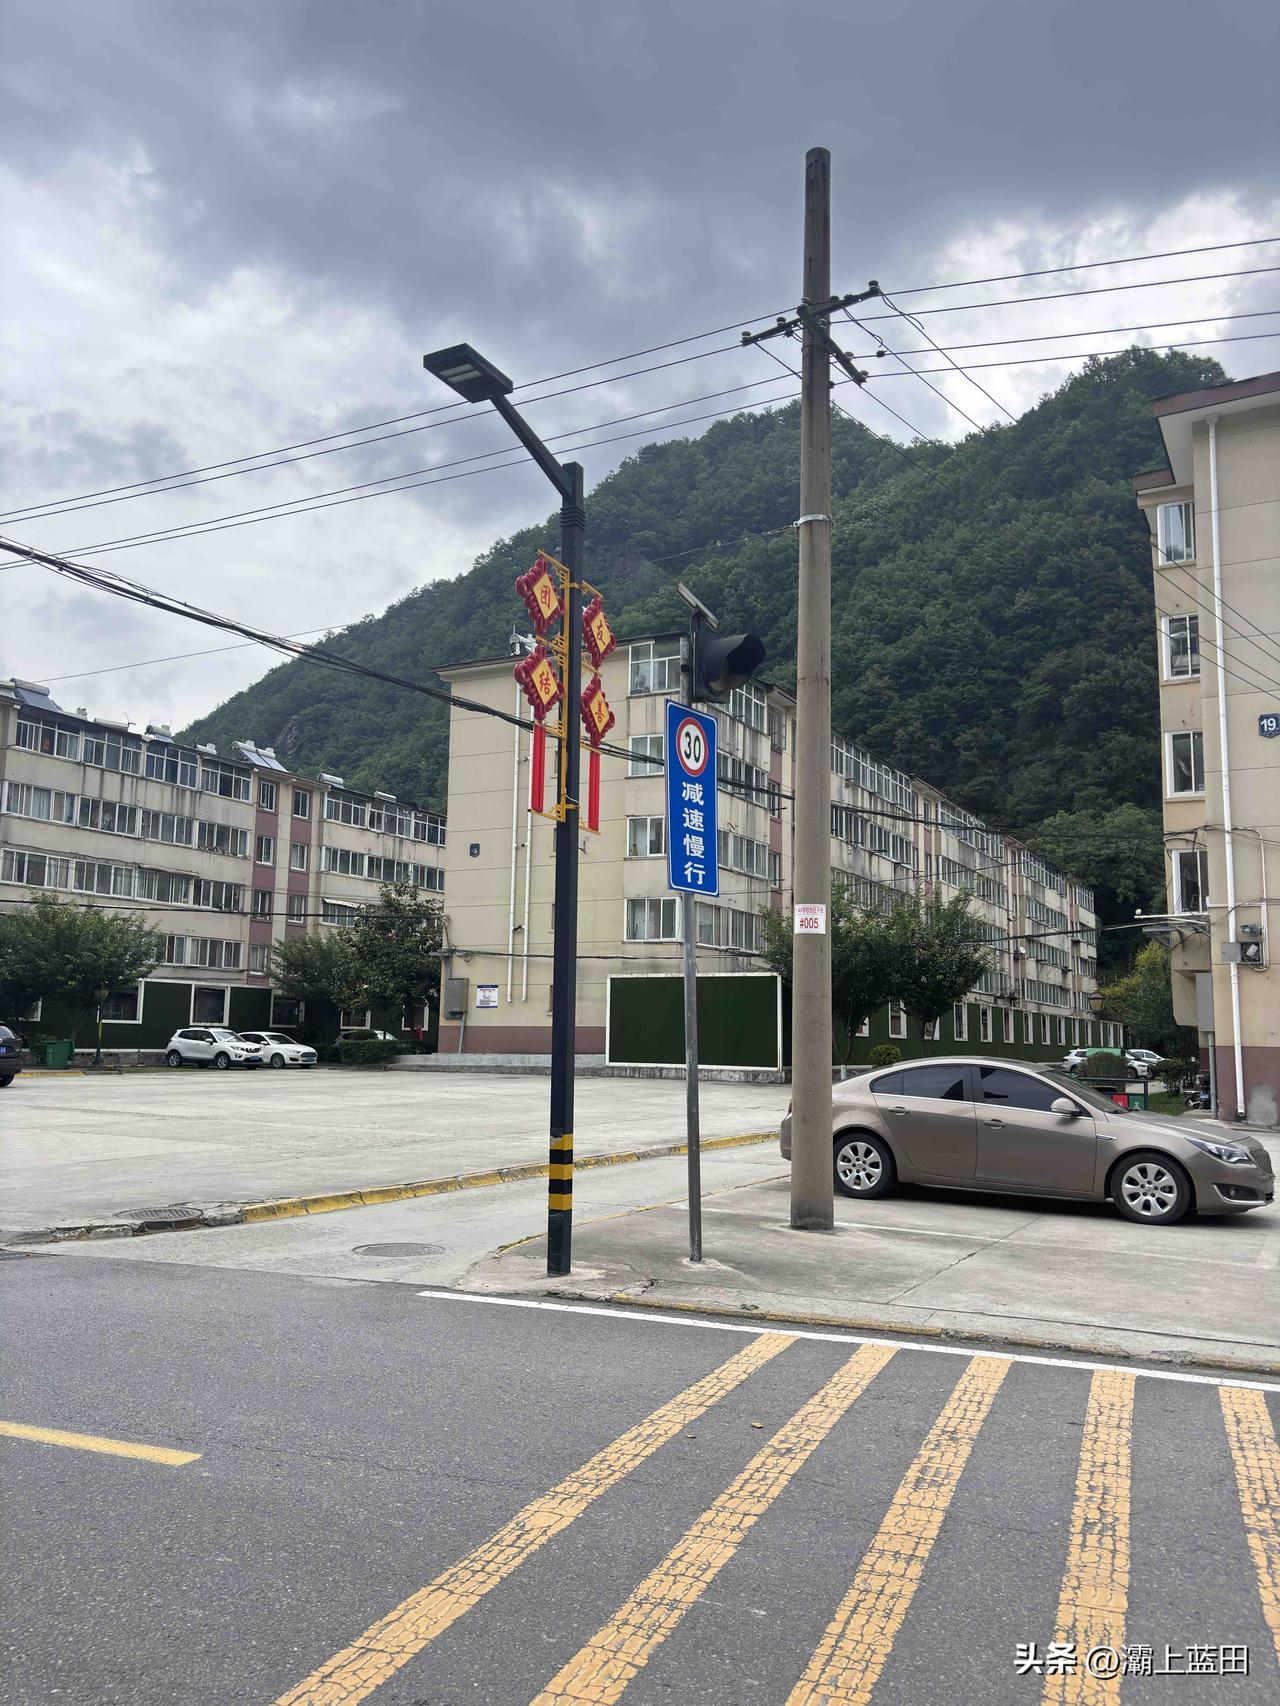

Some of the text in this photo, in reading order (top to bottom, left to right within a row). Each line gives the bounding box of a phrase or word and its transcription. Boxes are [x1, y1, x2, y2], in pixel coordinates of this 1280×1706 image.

[540, 585, 551, 609] 团
[540, 671, 551, 695] 结
[684, 731, 701, 763] 30
[681, 781, 706, 885] 减速慢行
[800, 917, 819, 929] #005
